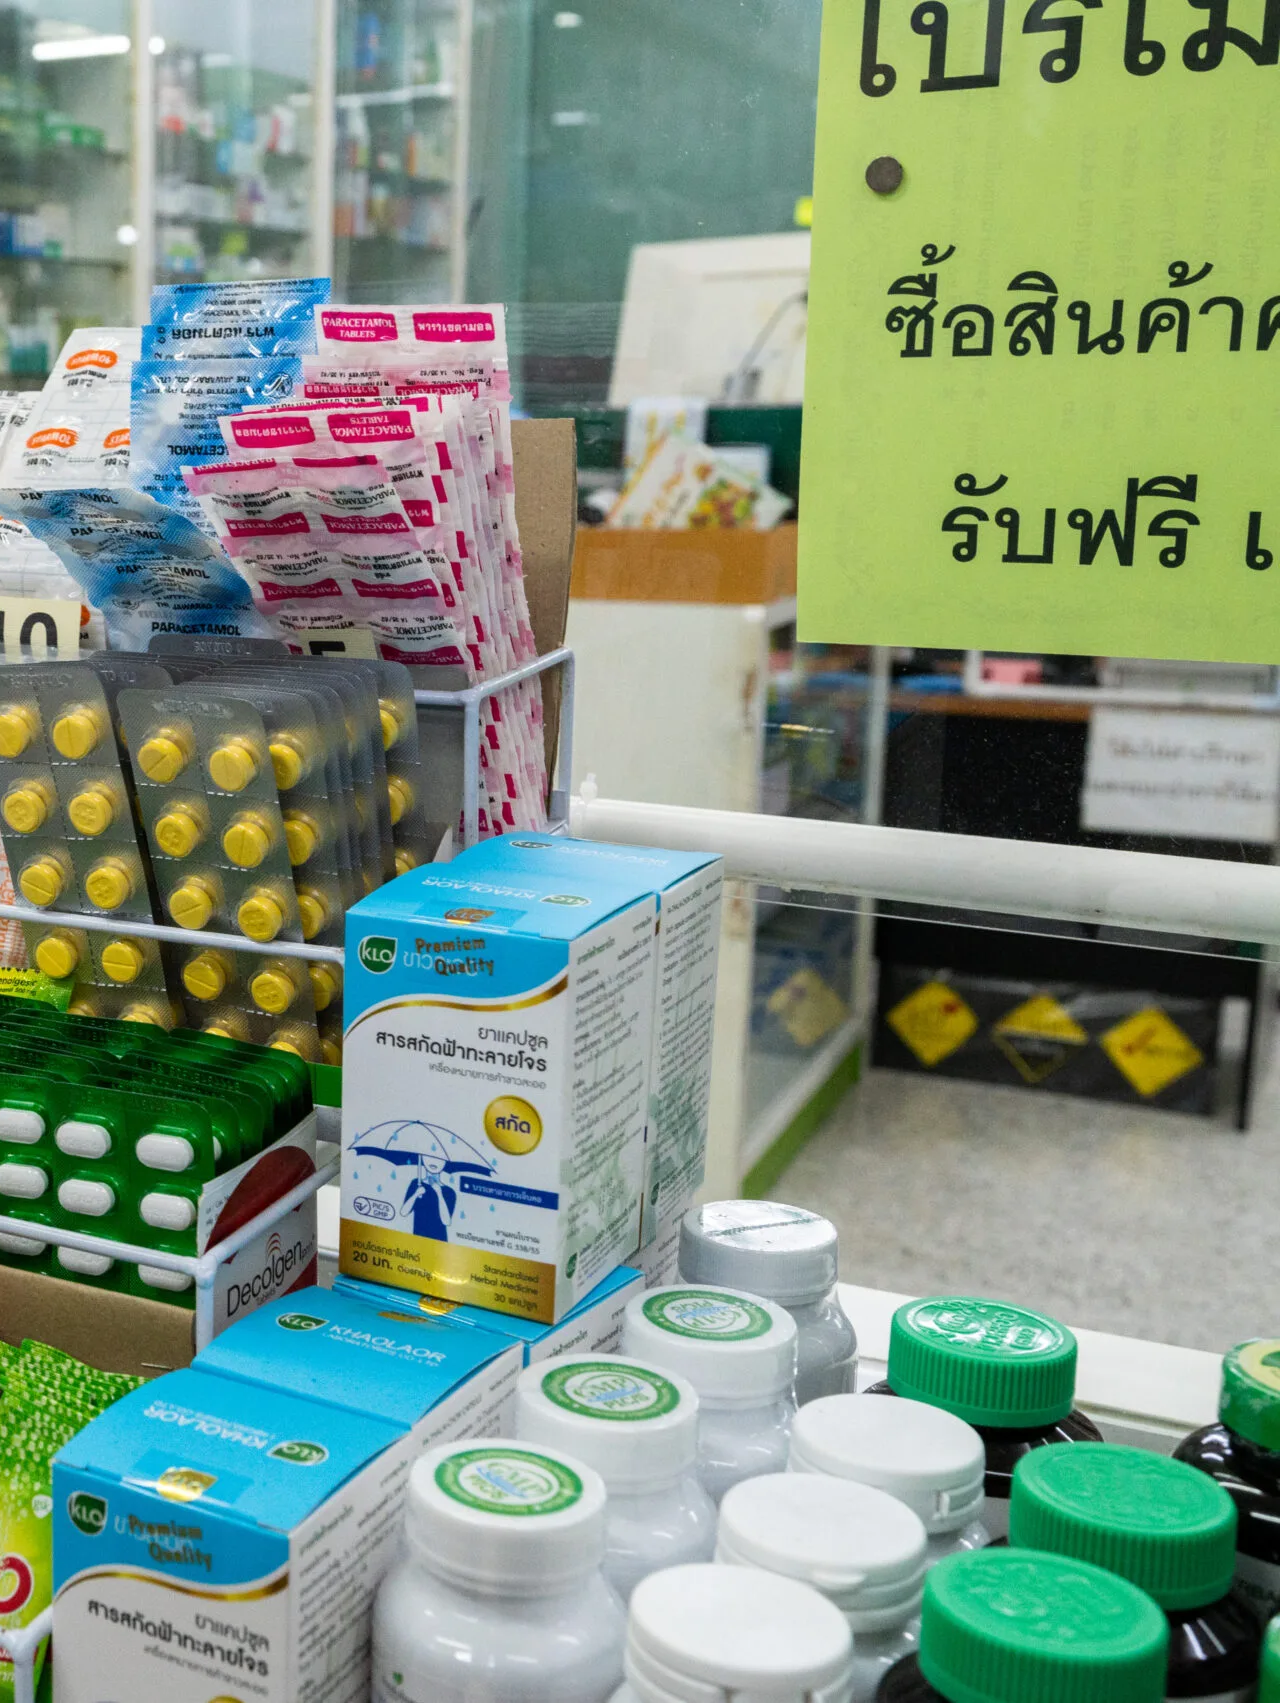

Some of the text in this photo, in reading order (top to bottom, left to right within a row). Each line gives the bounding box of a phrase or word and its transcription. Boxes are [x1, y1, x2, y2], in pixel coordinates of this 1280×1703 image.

[323, 316, 395, 329] PARACETAMOL
[339, 329, 376, 339] TABLETS
[349, 414, 389, 425] TABLETS
[332, 424, 413, 439] PARACETAMOL
[167, 444, 228, 457] CETAMOL
[941, 472, 1201, 569] รับฟรี
[361, 943, 396, 964] KLO
[414, 936, 486, 955] Premium
[434, 957, 495, 977] Quality
[477, 1026, 549, 1052] ยาแคปซูล
[375, 1030, 548, 1072] สารสกัดฟ้าทะลายโจร
[494, 1113, 532, 1135] สกัด
[352, 1251, 369, 1264] 20
[372, 1256, 393, 1271] มก.
[226, 1240, 303, 1318] Decolgen
[470, 1272, 539, 1296] Herbal Medicine
[483, 1264, 540, 1284] Standardized
[494, 1292, 506, 1303] 30
[280, 1314, 317, 1329] KLO
[329, 1325, 446, 1364] KHAOLAOR
[143, 1404, 269, 1450] KHAOLAOR
[70, 1503, 105, 1527] KLO
[127, 1513, 202, 1540] Premium
[148, 1541, 212, 1573] Quality
[194, 1612, 270, 1653] ยาแคปซูล
